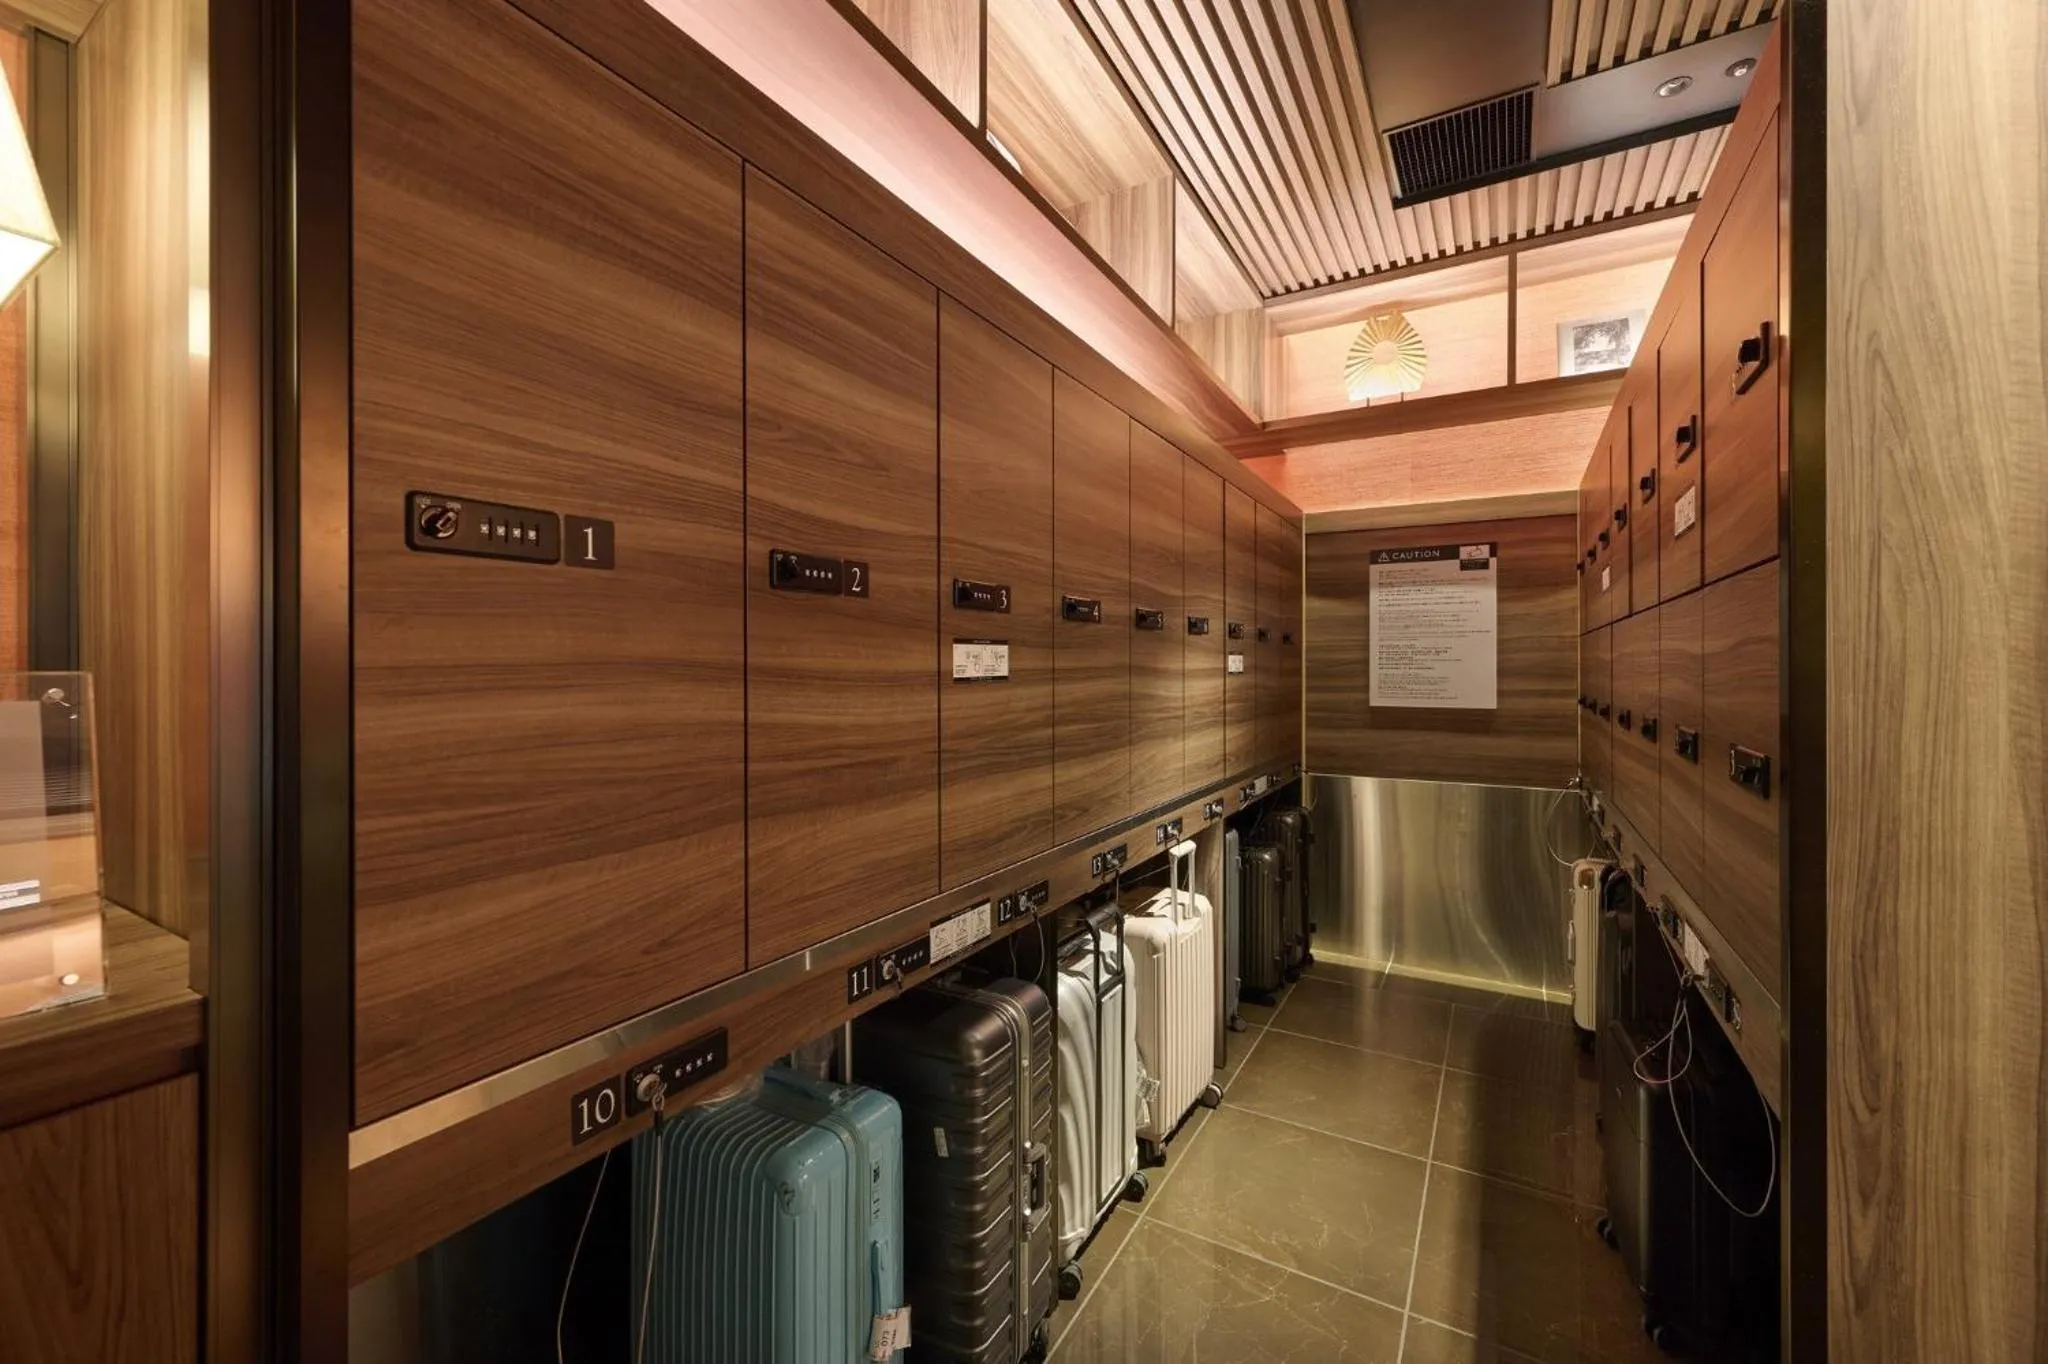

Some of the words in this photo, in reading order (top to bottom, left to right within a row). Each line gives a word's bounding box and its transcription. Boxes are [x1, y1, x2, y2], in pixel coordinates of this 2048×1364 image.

[583, 526, 598, 561] 1
[1392, 550, 1441, 560] CAUTION
[851, 567, 863, 592] 2
[1000, 589, 1007, 609] 3
[1093, 856, 1101, 875] 13
[1000, 899, 1012, 921] 12
[851, 966, 871, 997] 11
[578, 1088, 615, 1135] 10
